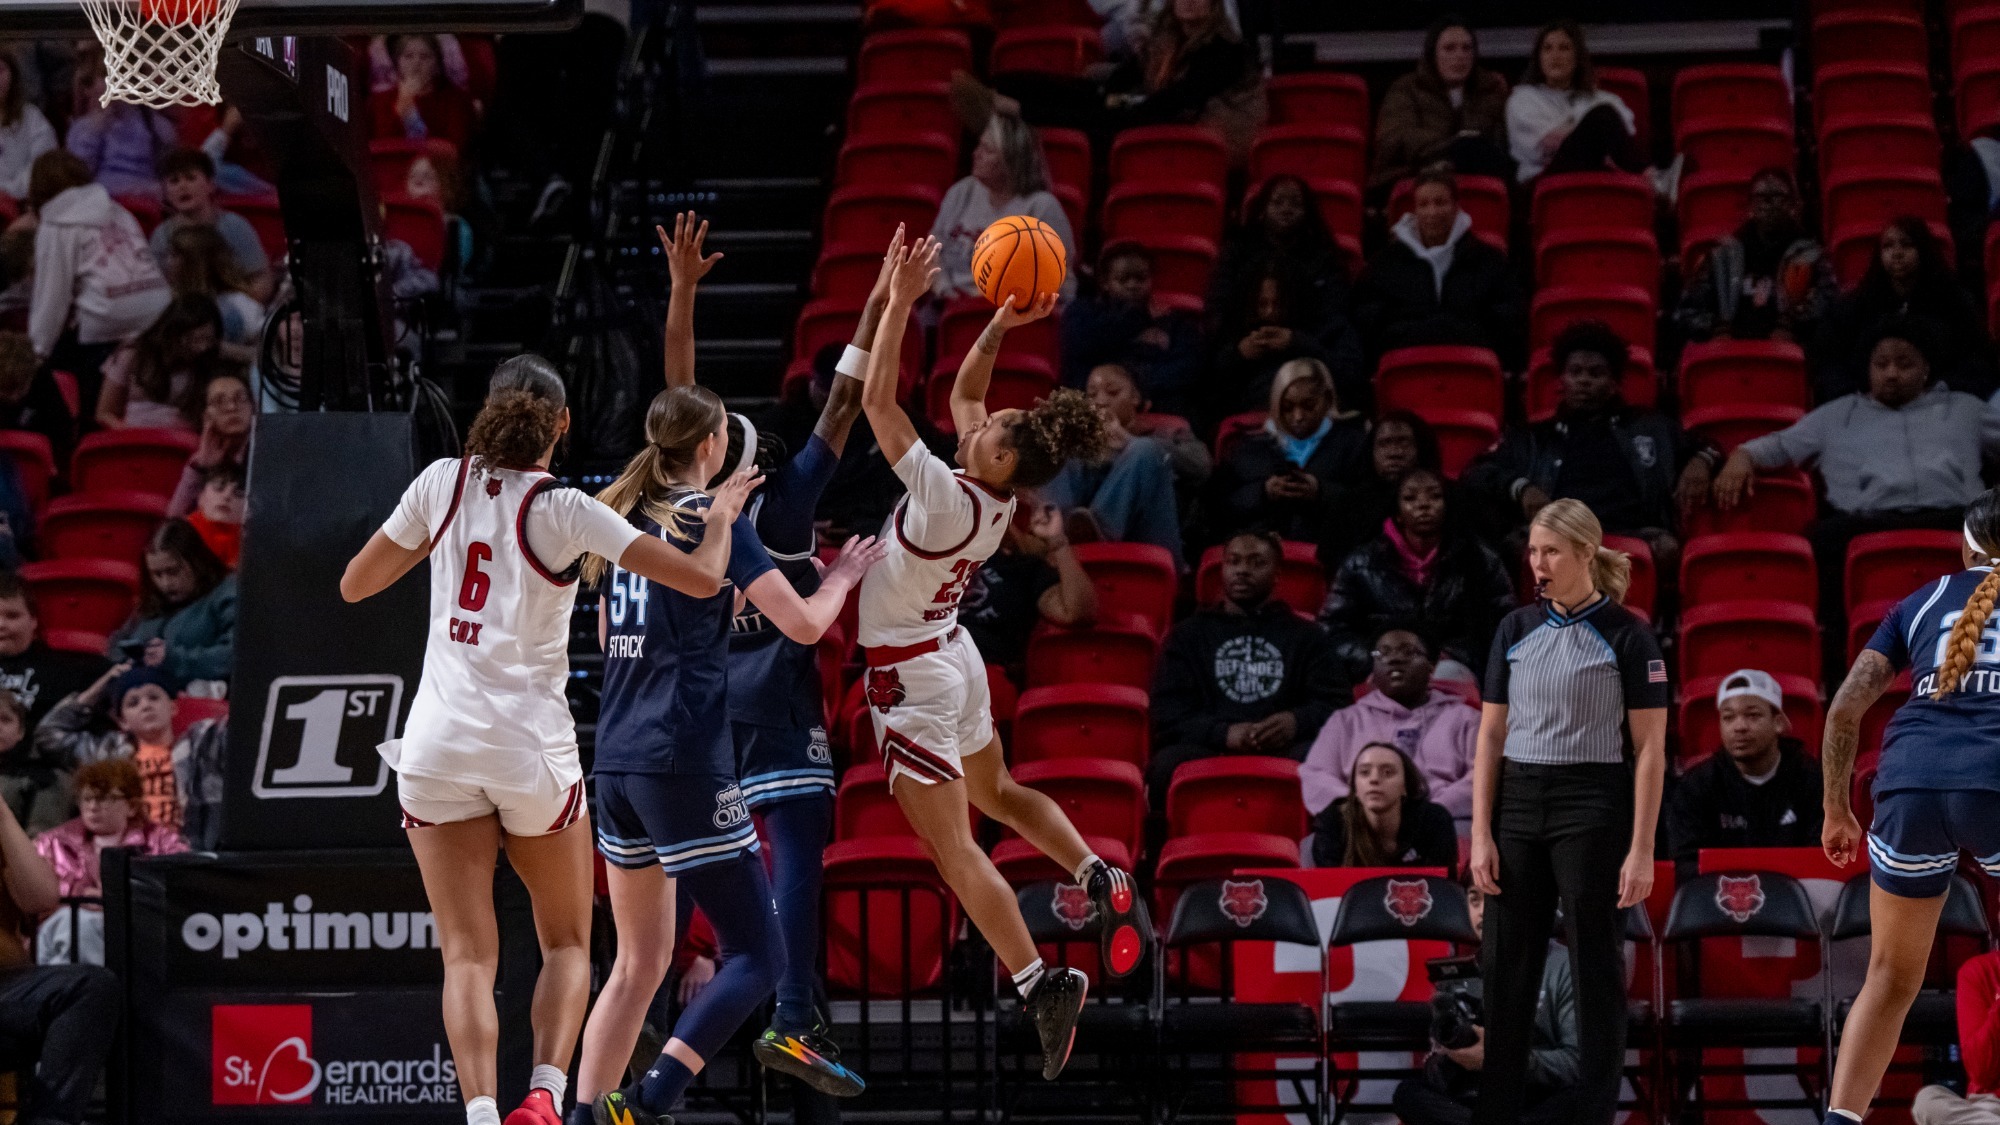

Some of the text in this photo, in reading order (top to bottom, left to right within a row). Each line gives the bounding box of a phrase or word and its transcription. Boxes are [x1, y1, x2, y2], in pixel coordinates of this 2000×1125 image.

[326, 64, 349, 123] PRO
[978, 260, 993, 295] EVO
[458, 541, 493, 612] 6
[610, 563, 650, 627] 54
[449, 616, 483, 646] COX
[608, 634, 646, 659] STACK
[1916, 670, 2000, 697] CLYTO
[713, 800, 751, 829] ODU
[223, 1055, 256, 1086] St.
[325, 1084, 458, 1104] HEALTHCARE
